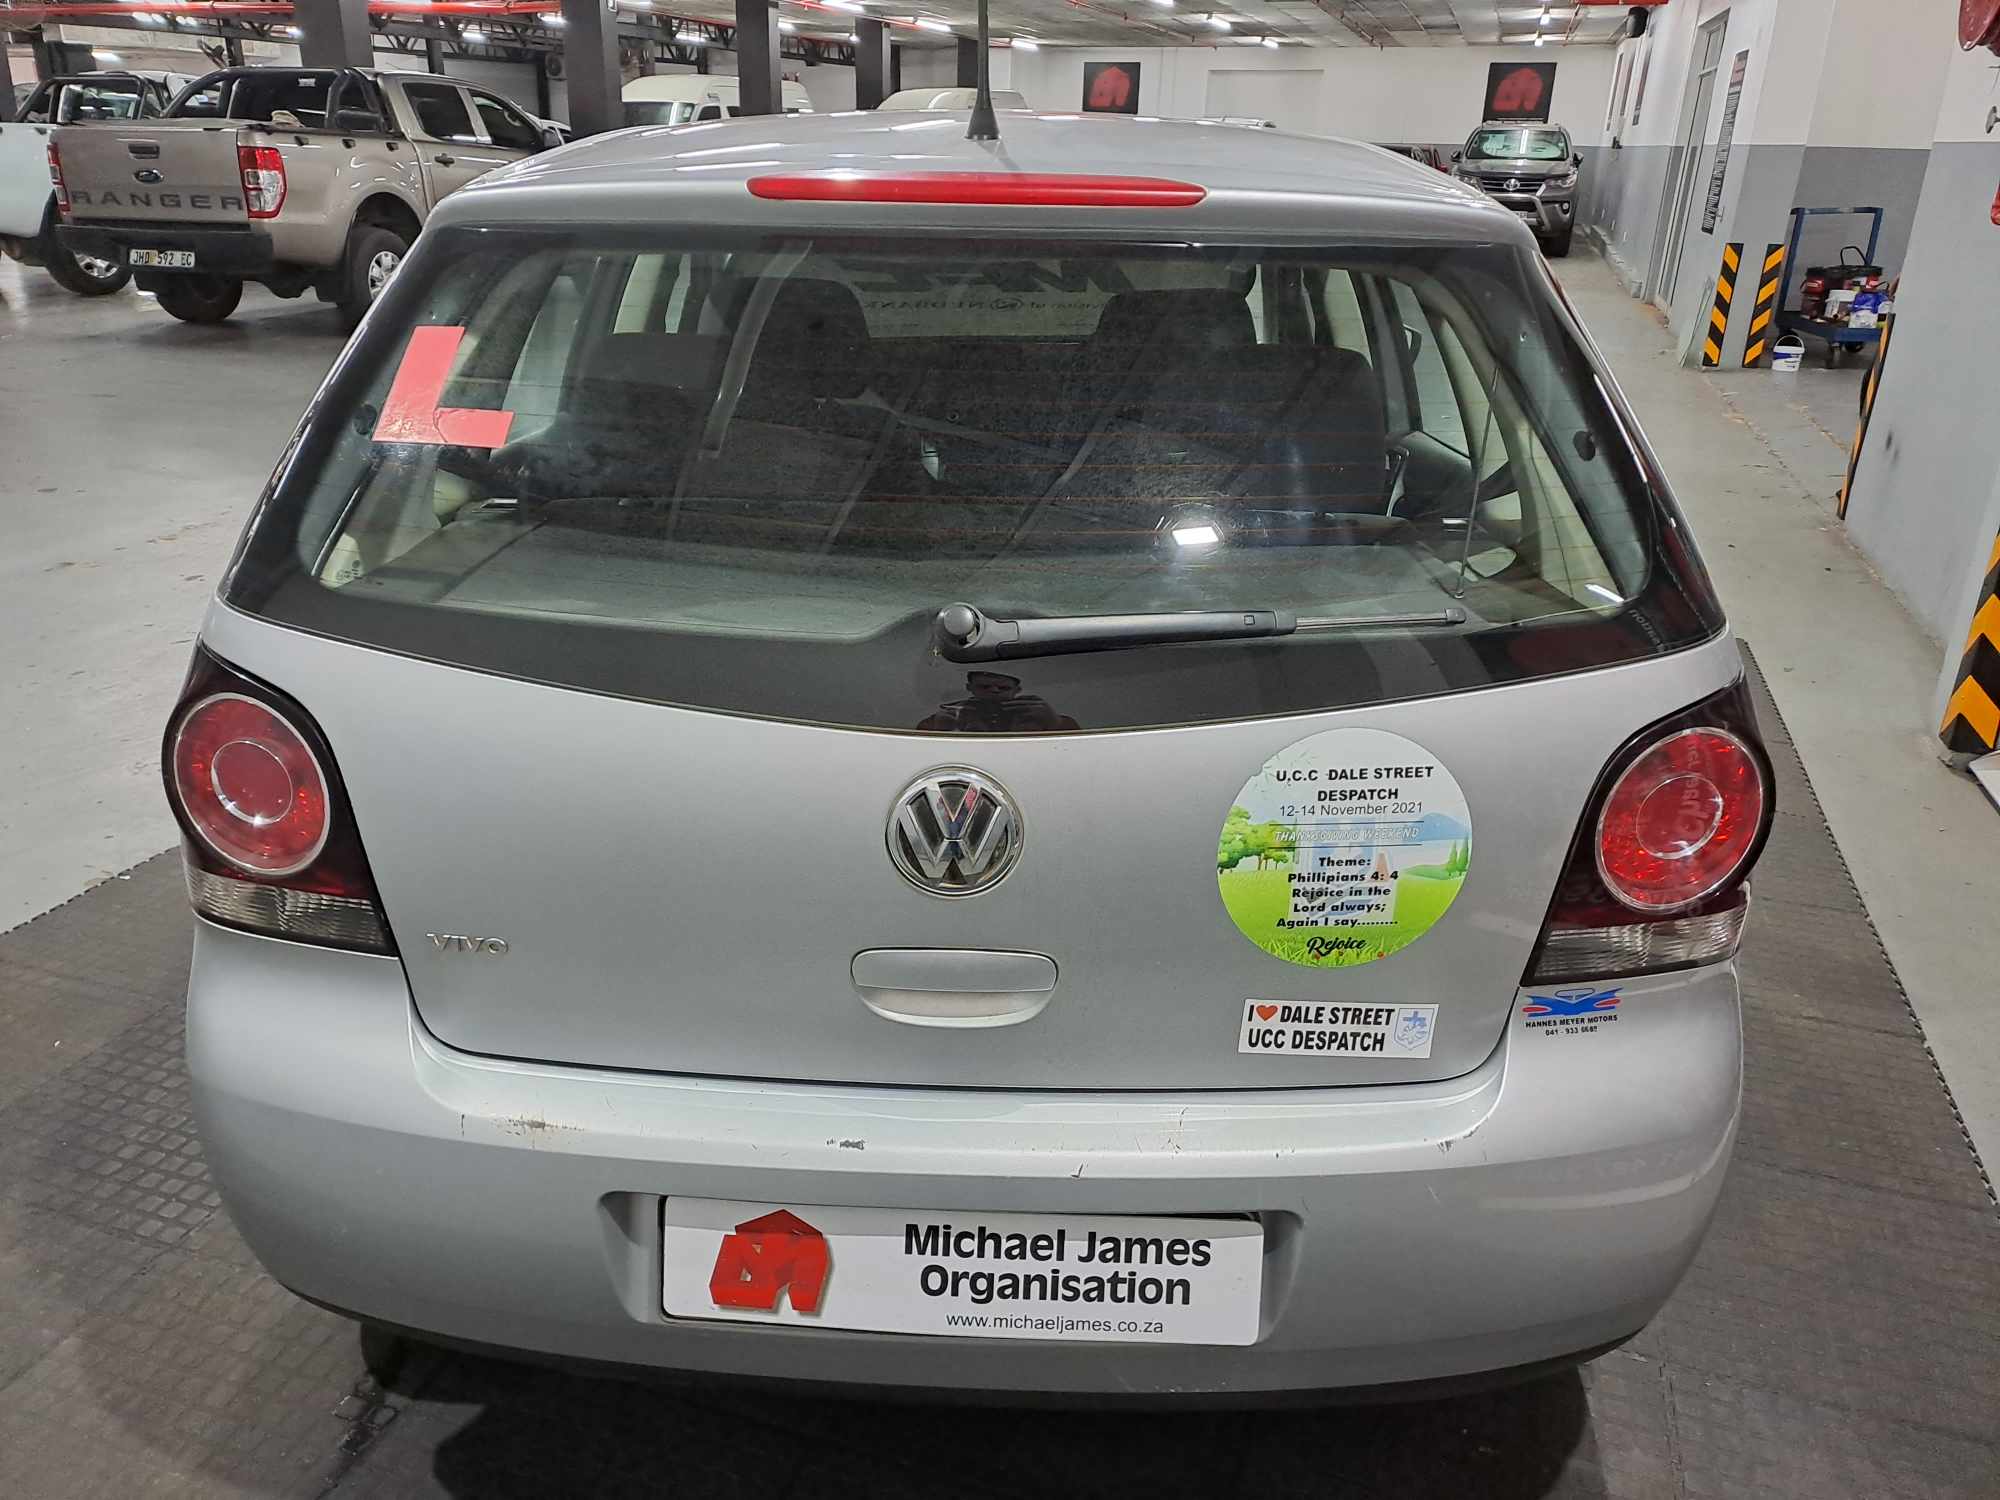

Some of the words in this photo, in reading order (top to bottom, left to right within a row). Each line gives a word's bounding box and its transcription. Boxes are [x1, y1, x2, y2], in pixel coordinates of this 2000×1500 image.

[70, 190, 243, 212] RANGER
[157, 252, 174, 265] 592
[1276, 769, 1318, 782] U.C.C
[1328, 767, 1369, 781] DALE
[1373, 766, 1434, 779] STREET
[1317, 788, 1399, 802] DESPATCH
[1280, 804, 1316, 817] 12-14
[1320, 804, 1388, 816] November
[1391, 801, 1423, 814] 2021
[1319, 857, 1371, 867] Theme:
[1288, 872, 1365, 884] Phillipians
[1292, 887, 1344, 900] Rejoice
[1349, 886, 1362, 897] in
[1367, 886, 1391, 896] the
[1293, 902, 1326, 913] Lord
[1330, 902, 1386, 913] always;
[1276, 917, 1319, 929] Again
[1323, 917, 1329, 926] I
[425, 932, 508, 954] VIVO
[1306, 936, 1367, 957] Rejoice
[1248, 1004, 1255, 1022] I
[1280, 1005, 1325, 1024] DALE
[1328, 1007, 1395, 1026] STREET
[1525, 1020, 1557, 1028] HANNES
[1559, 1017, 1585, 1026] MEYER
[1587, 1015, 1618, 1024] MOTORS
[1248, 1028, 1286, 1049] UCC
[1291, 1030, 1386, 1052] DESPATCH
[904, 1223, 1066, 1262] Michael
[1077, 1231, 1212, 1266] James
[920, 1264, 1191, 1305] Organisation
[946, 1313, 1164, 1334] www.michaeljames.co.za
